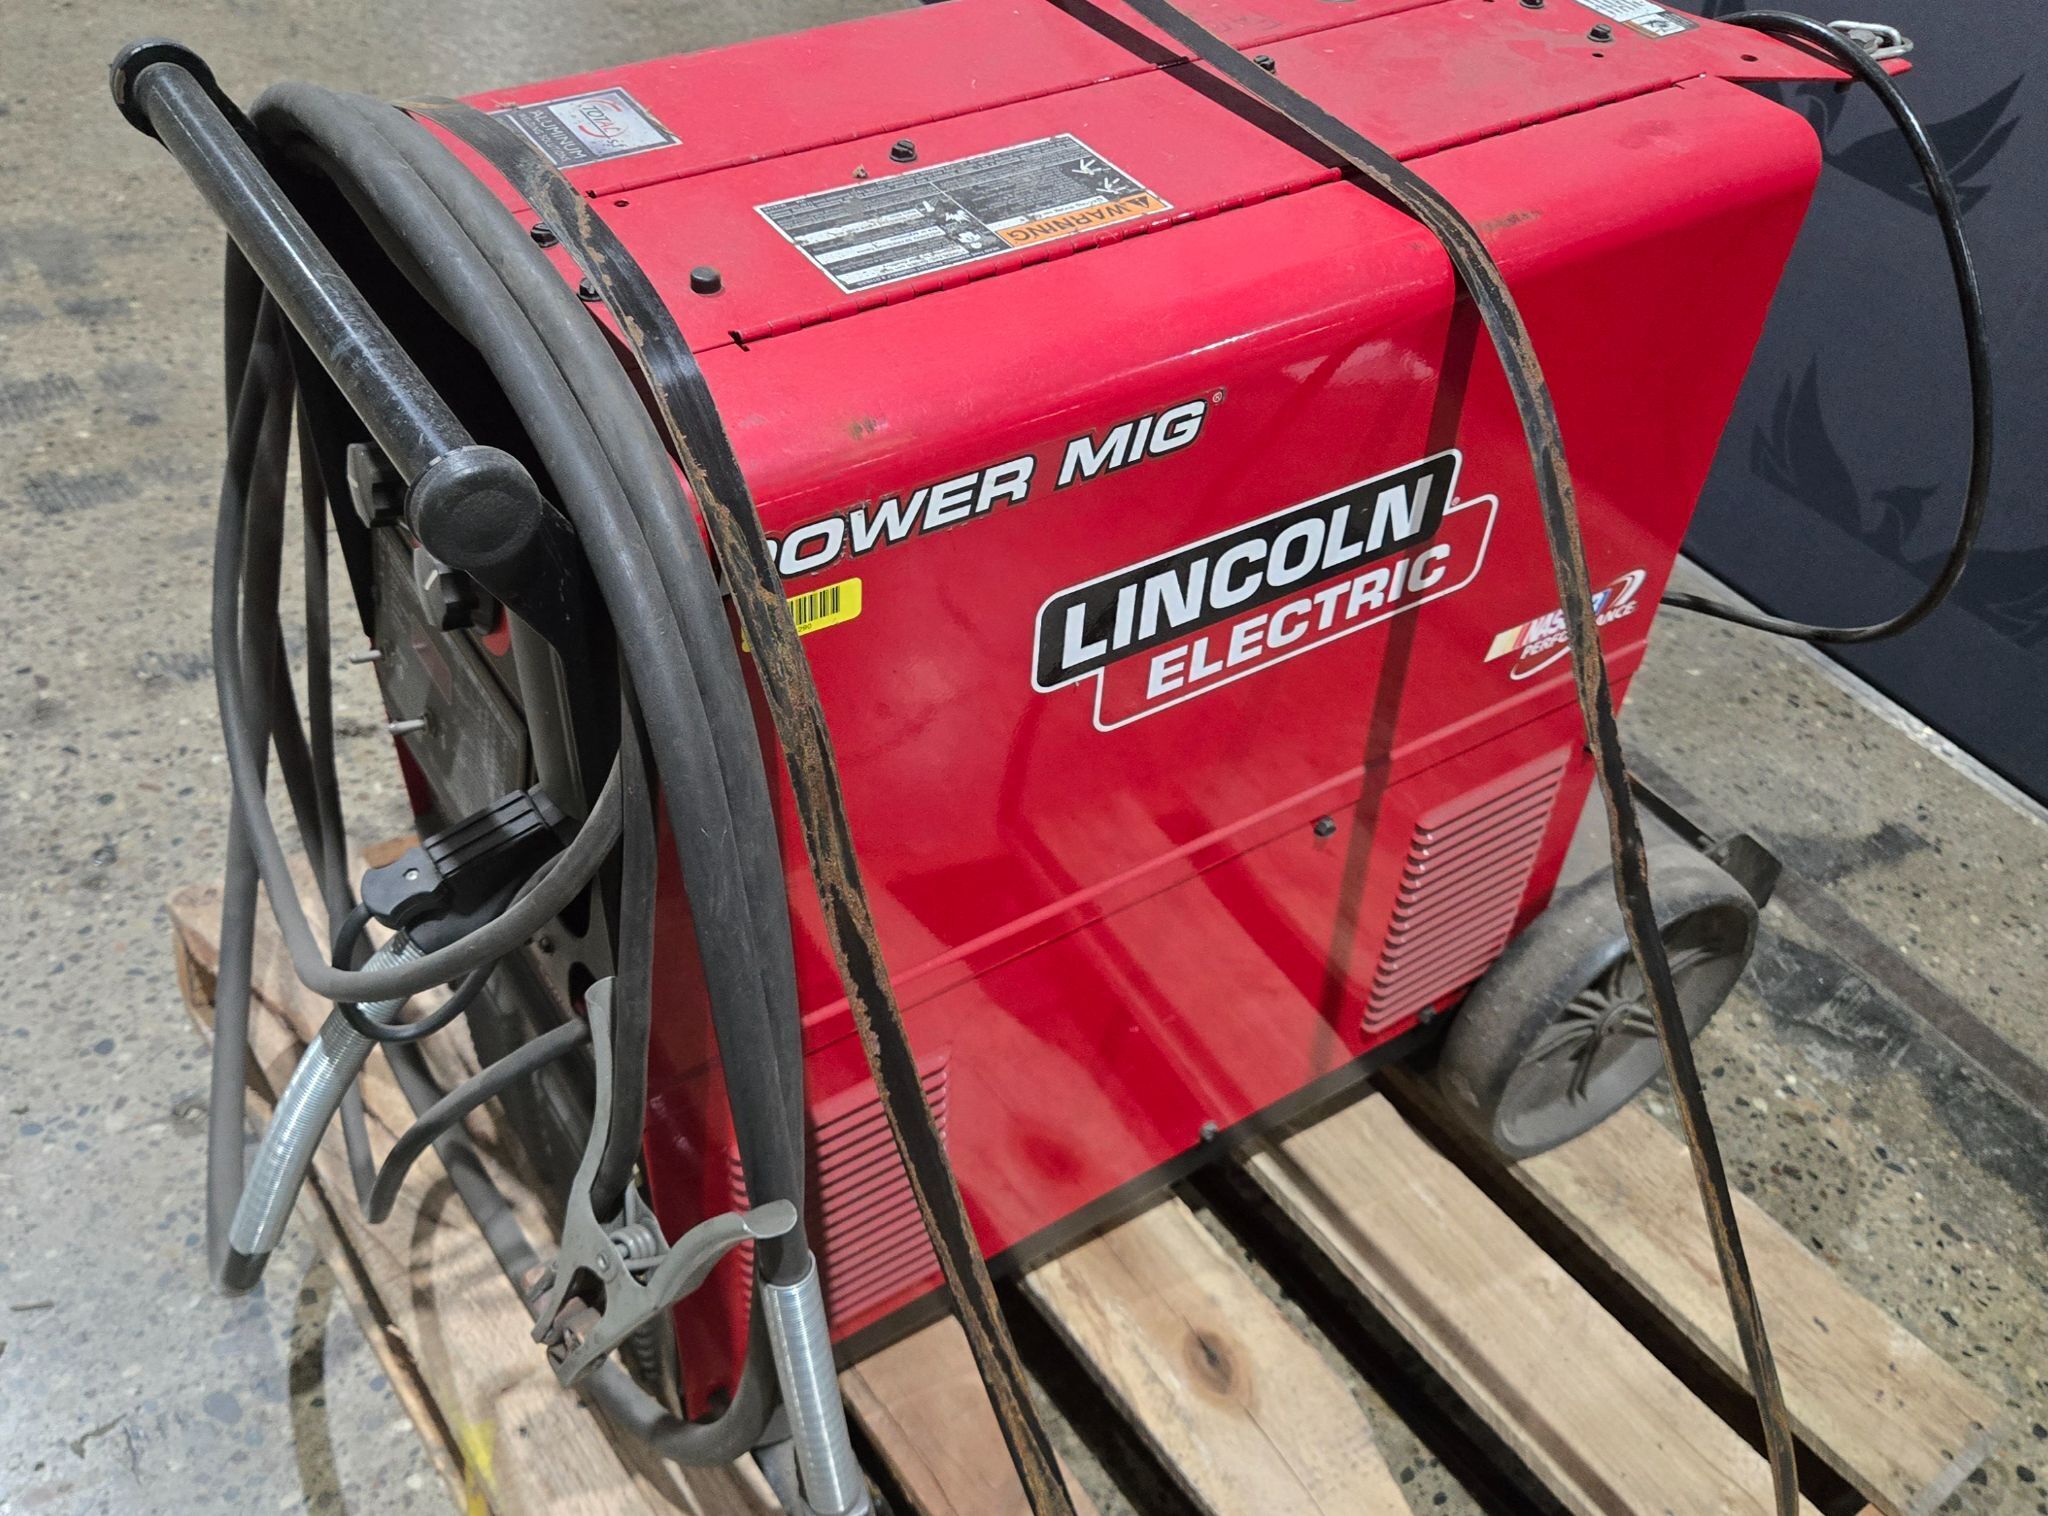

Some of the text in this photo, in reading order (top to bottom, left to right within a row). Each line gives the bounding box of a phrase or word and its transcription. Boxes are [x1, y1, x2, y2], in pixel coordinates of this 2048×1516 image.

[529, 109, 587, 160] ALUMINUM
[1008, 202, 1132, 242] WARNING
[766, 400, 1206, 575] OWER MIG
[1061, 474, 1434, 669] LINCOLN
[1146, 543, 1451, 700] ELECTRIC
